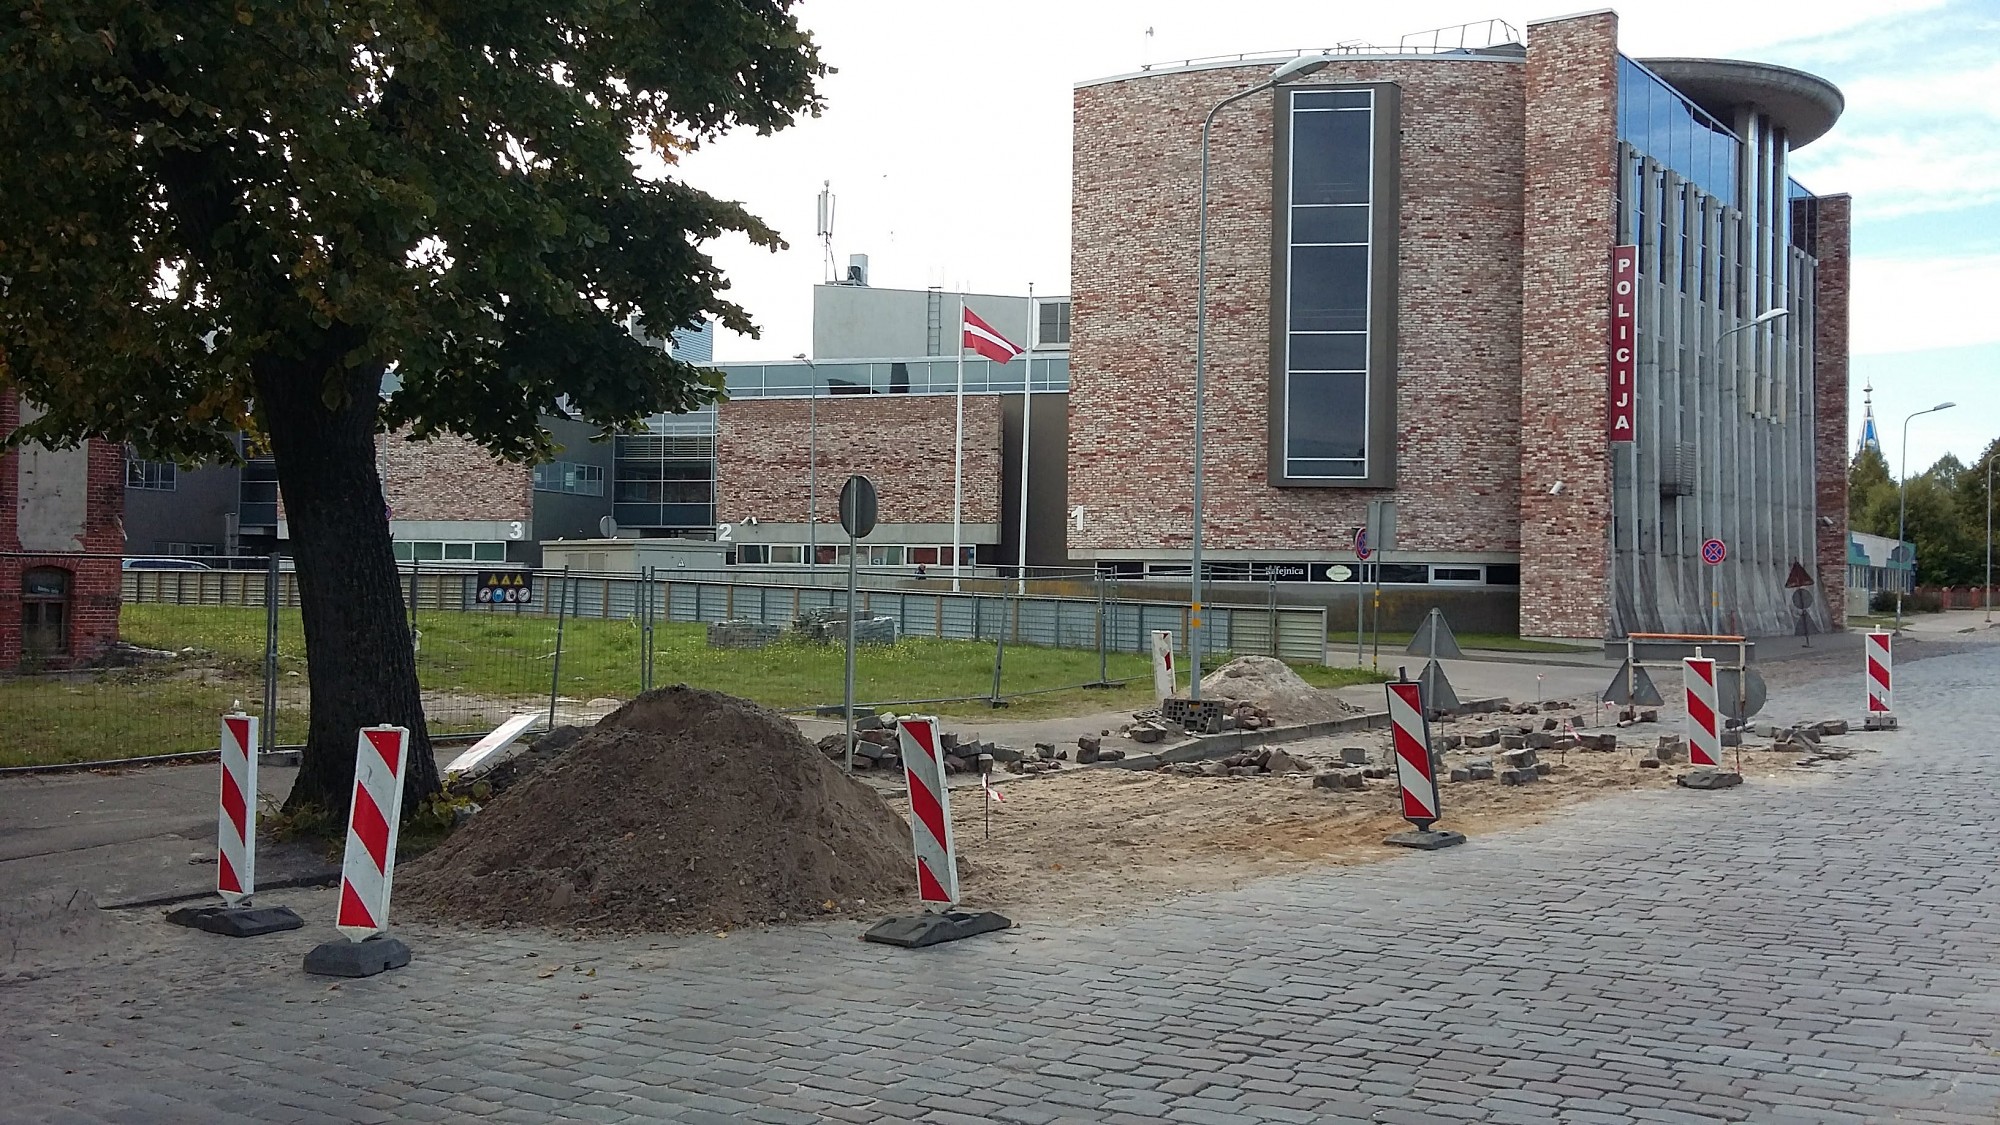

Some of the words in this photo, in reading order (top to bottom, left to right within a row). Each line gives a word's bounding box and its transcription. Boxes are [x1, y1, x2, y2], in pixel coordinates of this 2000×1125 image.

[1614, 258, 1631, 430] POLICIJA
[1071, 505, 1084, 531] 1
[509, 521, 523, 539] 3
[718, 523, 732, 541] 2
